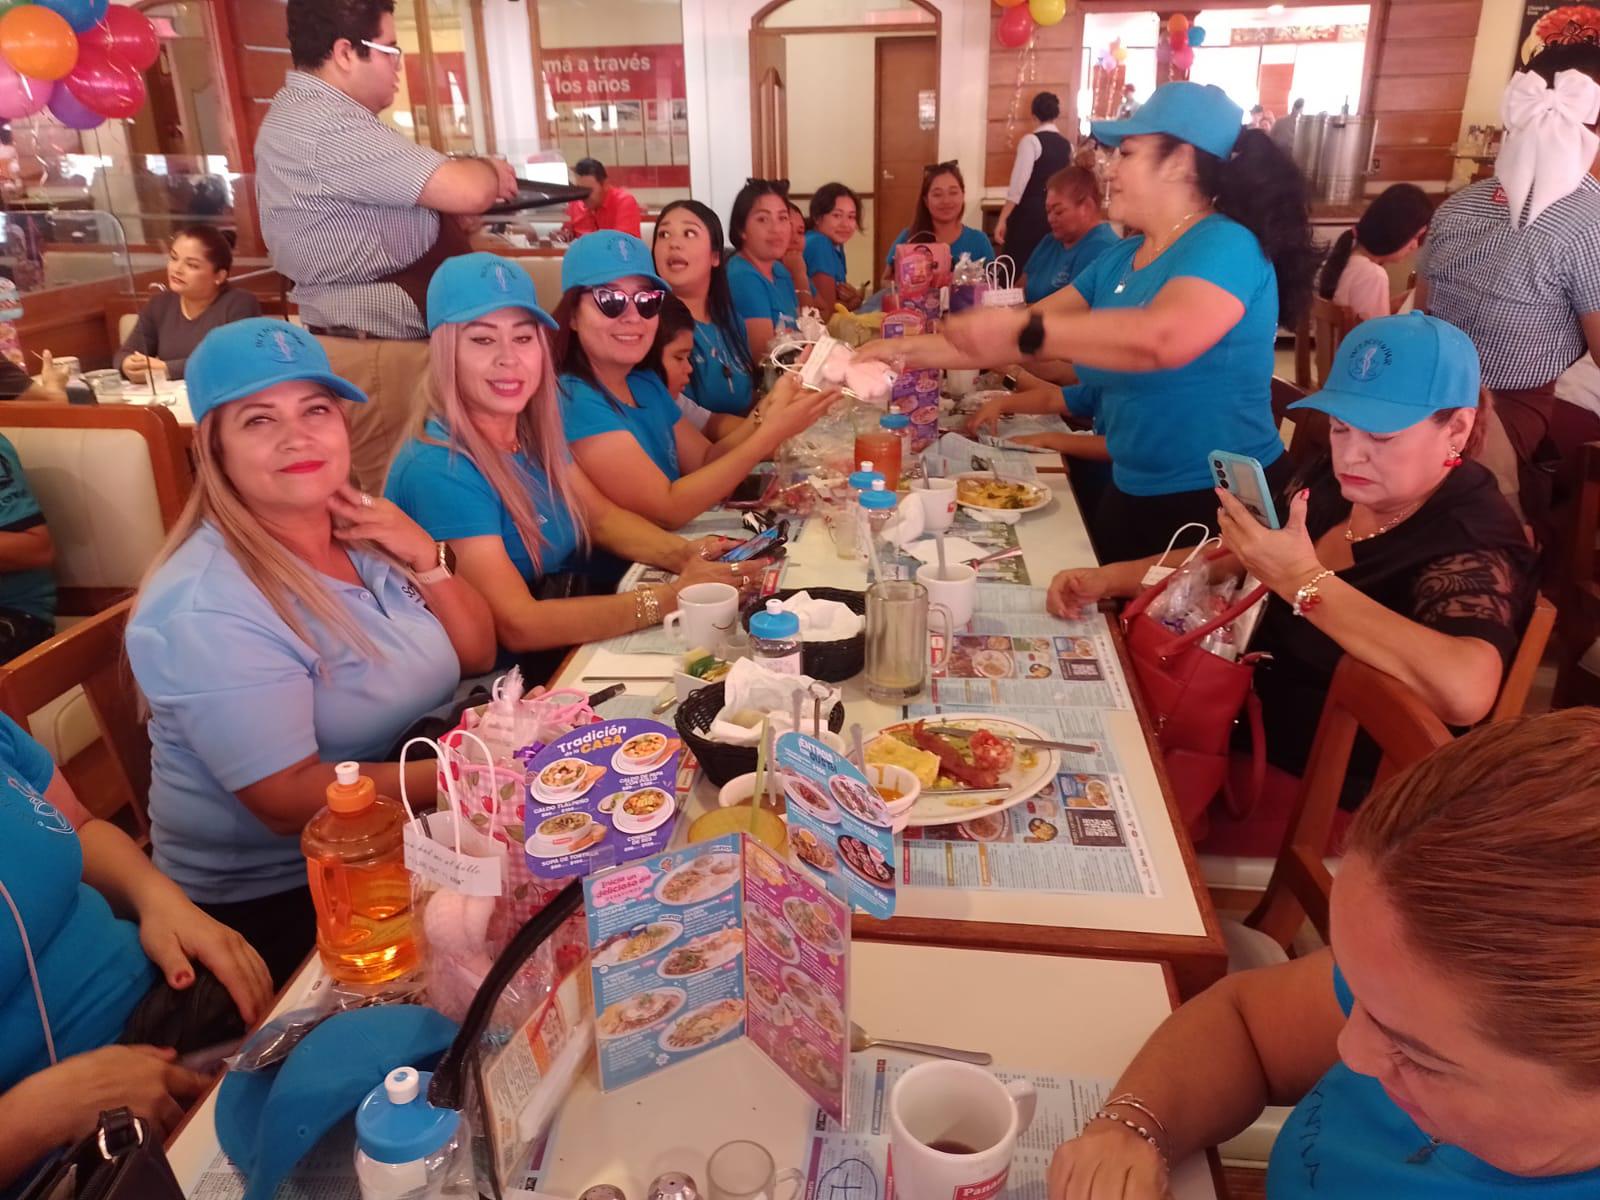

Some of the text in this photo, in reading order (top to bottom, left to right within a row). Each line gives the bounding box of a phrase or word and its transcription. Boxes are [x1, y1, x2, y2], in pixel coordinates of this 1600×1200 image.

[578, 59, 588, 72] a
[594, 52, 650, 71] través
[556, 75, 630, 94] los años
[557, 725, 627, 753] Tradición
[580, 735, 623, 754] CASA
[533, 805, 557, 814] CALDO
